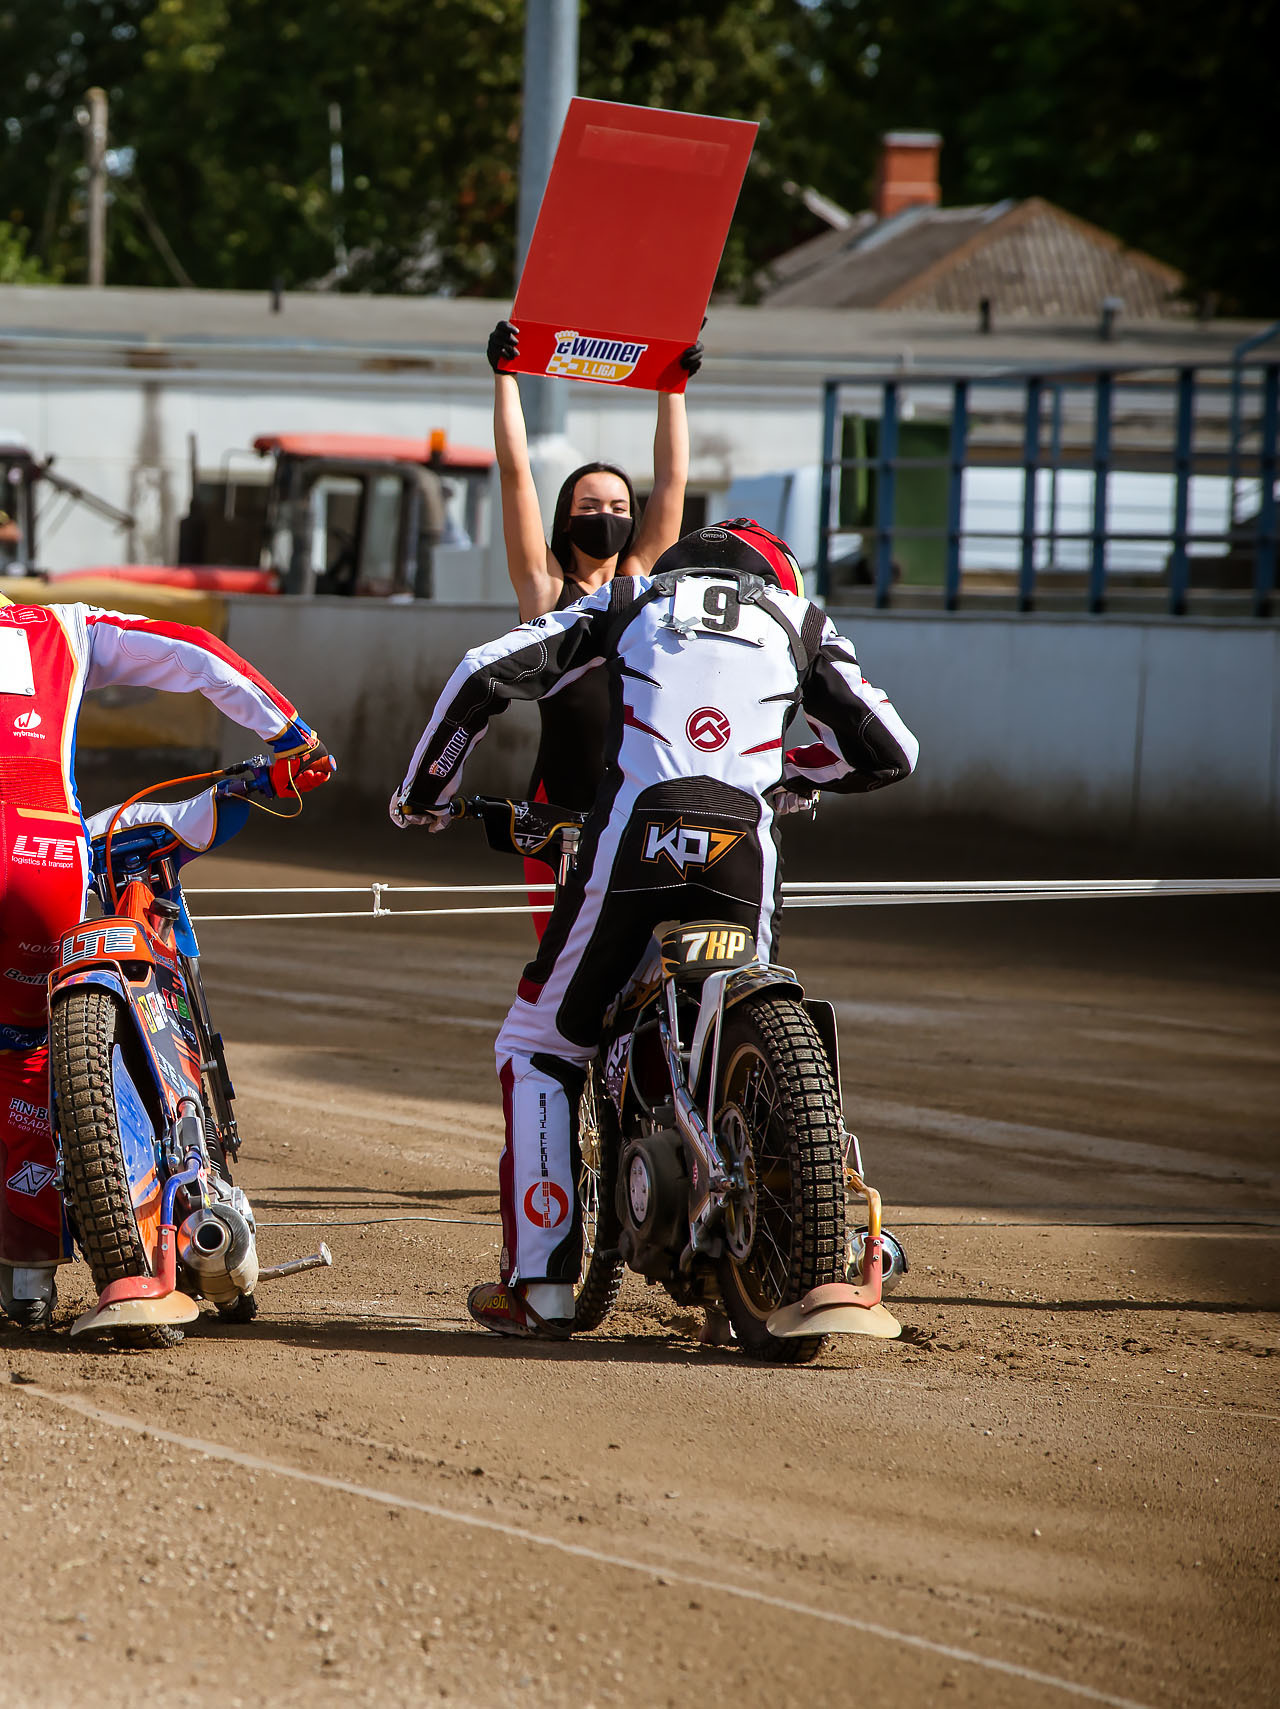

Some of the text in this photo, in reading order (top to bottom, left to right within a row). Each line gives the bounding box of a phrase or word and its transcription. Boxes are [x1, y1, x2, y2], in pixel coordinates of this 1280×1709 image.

[556, 337, 646, 363] eWinner
[591, 363, 616, 377] LIGA
[702, 585, 740, 632] 9
[435, 727, 469, 778] eWinner
[12, 855, 41, 866] logistics
[48, 860, 74, 869] transport
[13, 835, 76, 861] LTE
[645, 826, 738, 870] KP7
[62, 927, 137, 966] LTE
[681, 930, 746, 964] 7KP
[539, 1092, 552, 1229] SAULES SPORTA KLUBS
